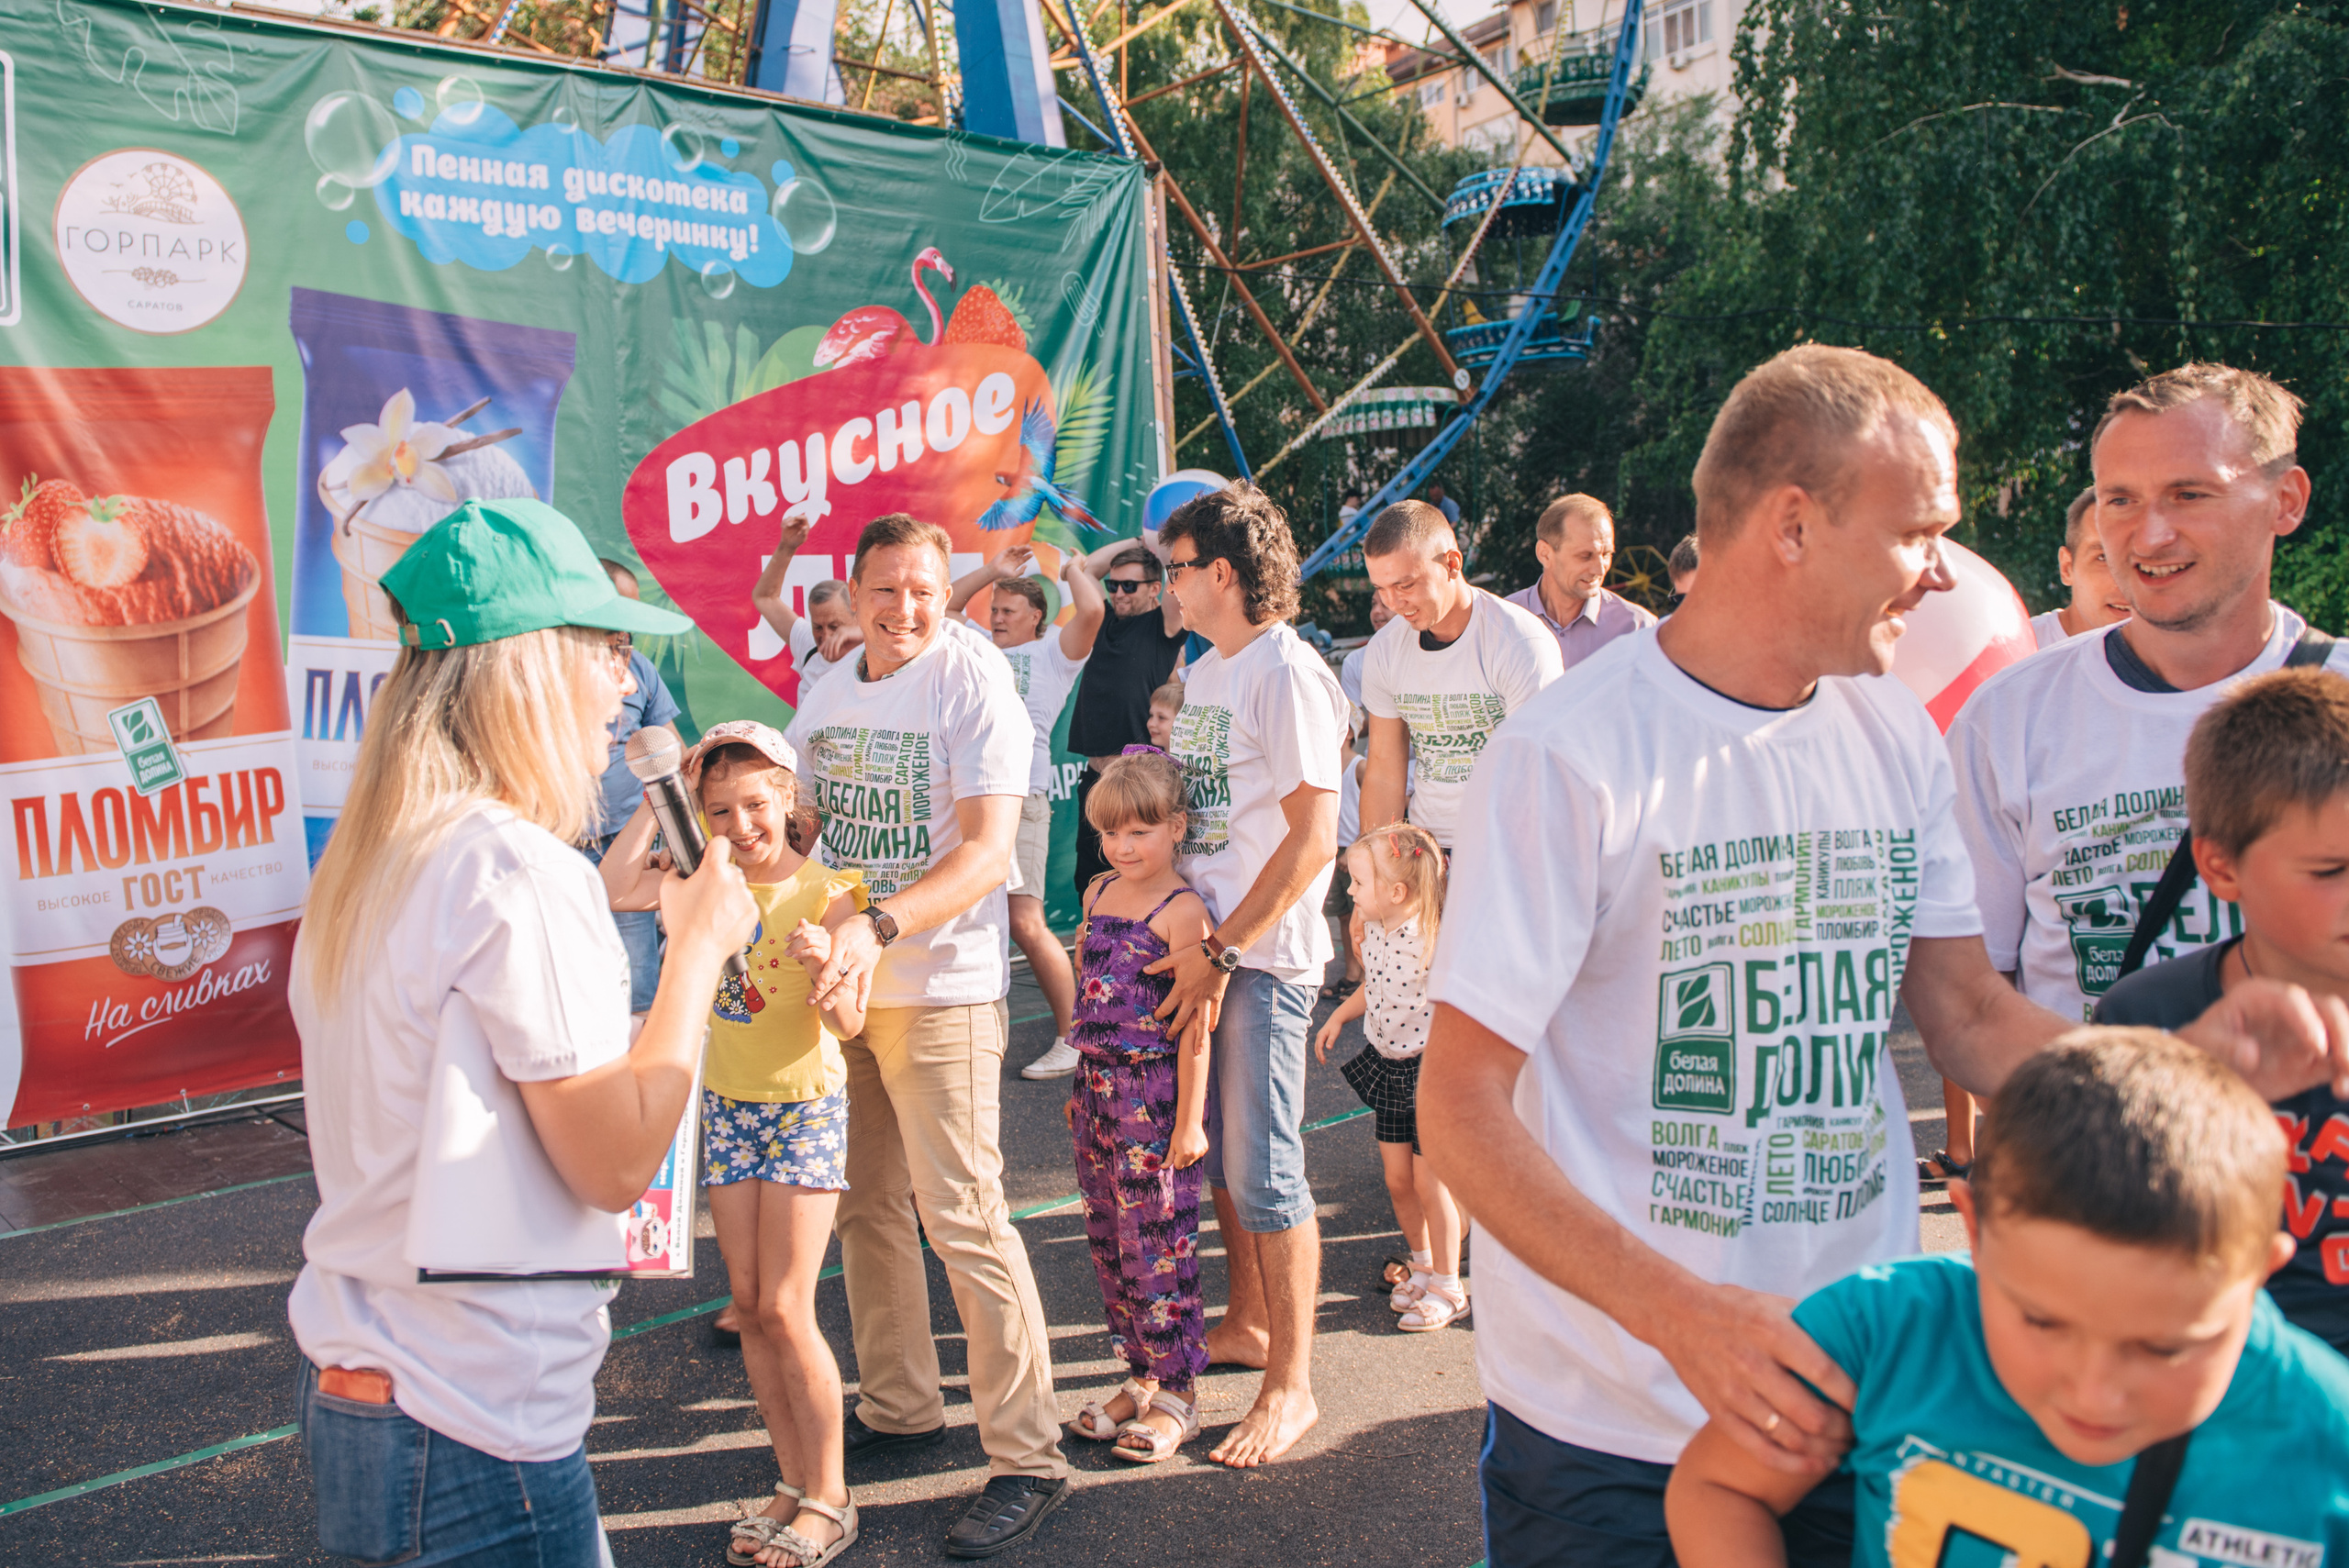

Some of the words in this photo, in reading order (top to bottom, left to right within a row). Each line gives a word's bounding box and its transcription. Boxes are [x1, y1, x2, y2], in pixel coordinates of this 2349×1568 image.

[410, 144, 550, 190] Пенная
[562, 166, 748, 215] дискотека
[400, 191, 562, 239] каждую
[576, 206, 759, 262] вечеринку!
[66, 226, 238, 263] ГОРПАРК
[128, 299, 184, 312] САРАТОВ
[666, 372, 1016, 543] Вкусное
[1403, 694, 1431, 704] ДОЛИНА
[1469, 693, 1489, 728] САРАТОВ
[1450, 710, 1471, 718] ПЛЯЖ
[825, 726, 857, 740] ДОЛИНА
[874, 741, 898, 751] ЛЮБОВЬ
[137, 751, 165, 769] белая
[312, 760, 356, 772] ВЫСОК
[853, 728, 870, 781] ГАРМОНИЯ
[872, 751, 896, 764] ПЛЯЖ
[895, 732, 916, 785] САРАТОВ
[911, 731, 931, 822] МОРОЖЕНОЕ
[1444, 765, 1474, 775] ЛЮБО
[829, 781, 901, 824] БЕЛАЯ
[2114, 785, 2186, 818] ДОЛИН
[2160, 810, 2188, 818] ПЛОМБ
[11, 766, 285, 881] ПЛОМБИР
[830, 819, 931, 860] ДОЛИНА
[1835, 829, 1873, 850] ВОЛГА
[2065, 836, 2122, 866] АСТЬЕ
[1816, 830, 1831, 899] КАНИКУЛЫ
[1835, 855, 1876, 871] ЛЮБОВЬ
[2052, 865, 2094, 886] ЛЕТО
[2126, 849, 2176, 873] СОЛН
[37, 890, 112, 912] ВЫСОКОЕ
[122, 865, 206, 911] ГОСТ
[210, 862, 284, 885] КАЧЕСТВО
[1701, 872, 1770, 895] КАНИКУЛЫ
[1834, 877, 1877, 899] ПЛЯЖ
[1663, 900, 1736, 933] СЧАСТЬЕ
[1816, 902, 1878, 918] МОРОЖЕНОЕ
[1816, 920, 1879, 940] ПЛОМБИР
[1660, 935, 1702, 962] ЛЕТО
[150, 955, 200, 979] СВЕЖИЕ
[84, 995, 134, 1041] На
[139, 959, 272, 1022] сливках
[1669, 1051, 1719, 1072] белая
[1663, 1073, 1726, 1095] ДОЛИНА
[1652, 1120, 1720, 1151] ВОЛГА
[1777, 1115, 1825, 1129] ГАРМОНИЯ
[1653, 1151, 1749, 1178] МОРОЖЕНОЕ
[1766, 1133, 1795, 1196] ЛЕТО
[1652, 1171, 1747, 1210] СЧАСТЬЕ
[1762, 1199, 1831, 1225] СОЛНЦЕ
[1975, 1460, 2076, 1509] FASTER
